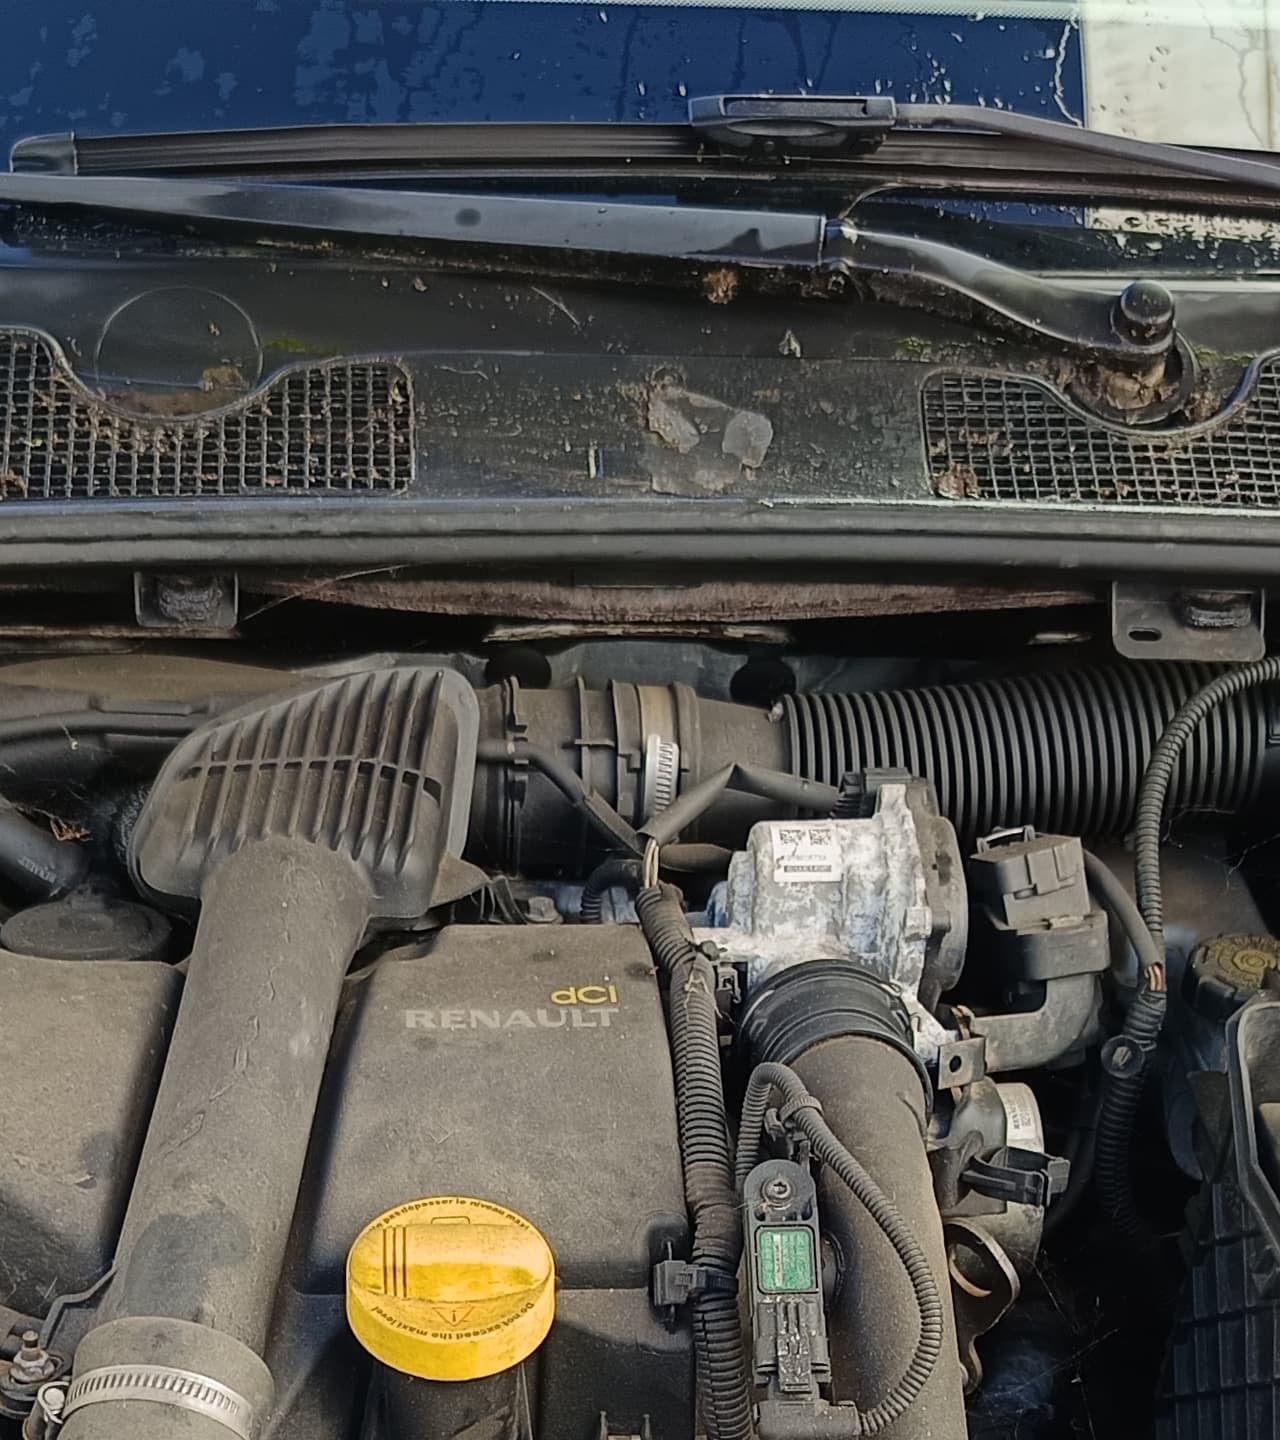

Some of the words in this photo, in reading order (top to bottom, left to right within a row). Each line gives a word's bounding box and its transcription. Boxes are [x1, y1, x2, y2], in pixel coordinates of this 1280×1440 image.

[405, 1007, 620, 1030] RENAULT
[371, 1306, 397, 1325] level
[395, 1321, 428, 1337] maxi
[431, 1331, 452, 1341] the
[456, 1323, 502, 1340] exceed
